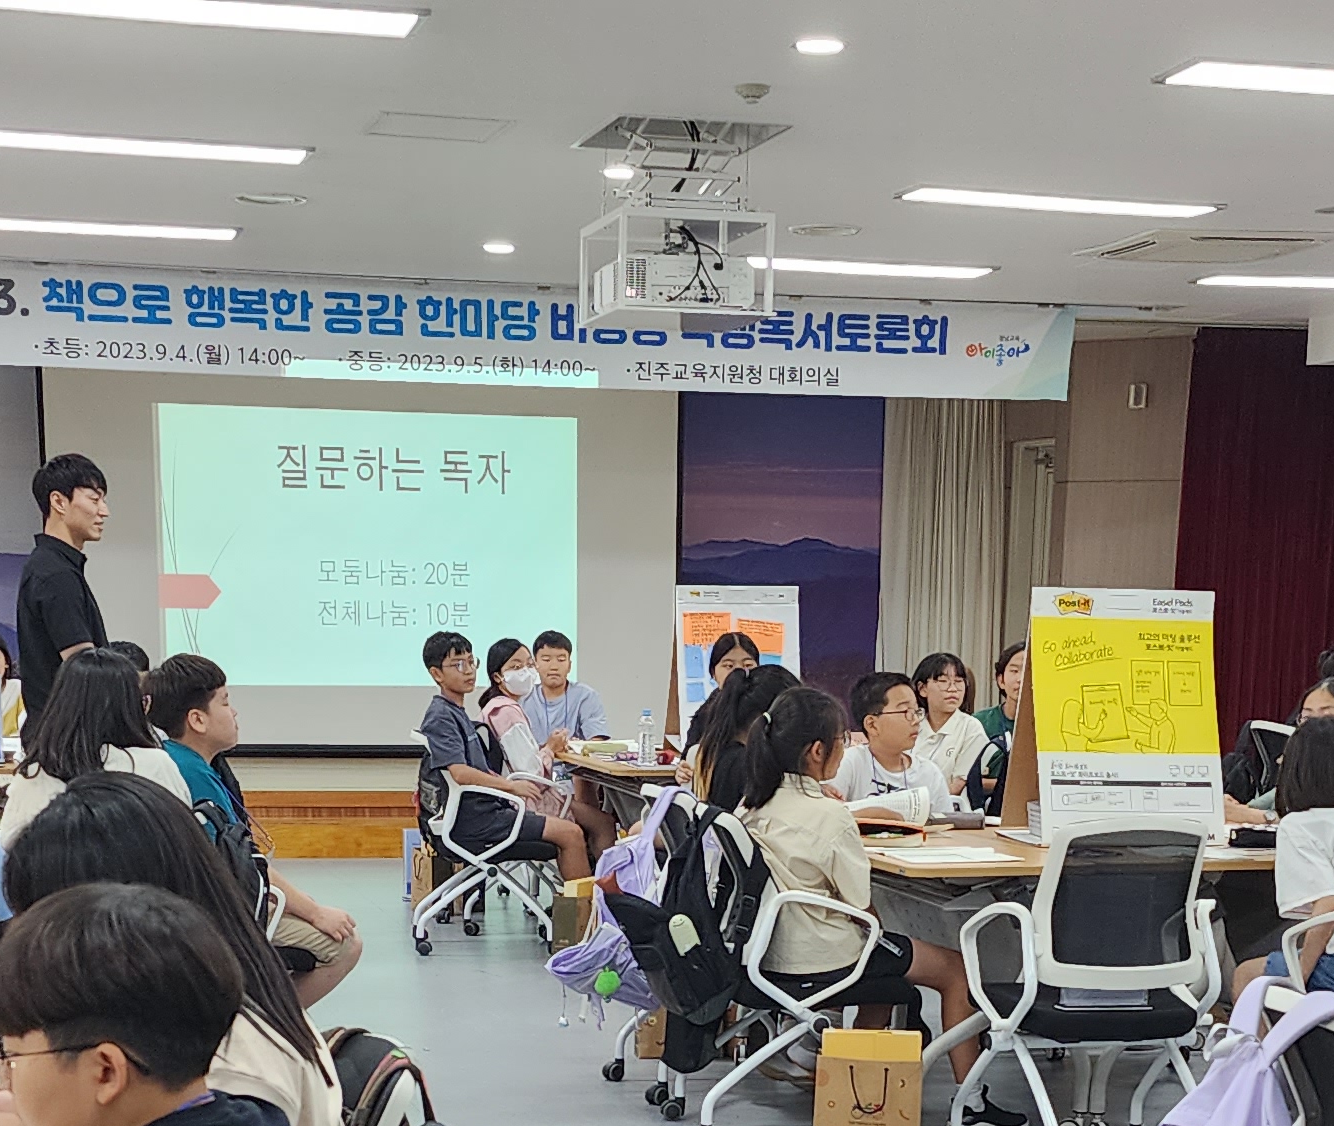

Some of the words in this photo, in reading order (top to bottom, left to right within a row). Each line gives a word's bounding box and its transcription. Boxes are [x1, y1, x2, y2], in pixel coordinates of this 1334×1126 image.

[42, 277, 173, 325] 책으로
[183, 284, 313, 333] 행복한
[323, 291, 407, 336] 공감
[417, 295, 541, 341] 한마당
[96, 340, 230, 366] 2023.9.4.(월)
[238, 347, 306, 366] 14:00~
[398, 353, 525, 377] 2023.9.5.(화)
[532, 358, 596, 377] 14:00~
[769, 366, 840, 387] 대회의실
[276, 444, 425, 492] 질문하는
[439, 449, 511, 495] 독자
[317, 559, 417, 586] 모둠나눔:
[423, 561, 471, 587] 20분
[317, 600, 417, 627] 전체나눔:
[425, 602, 471, 628] 10분
[1058, 598, 1090, 608] Post-it
